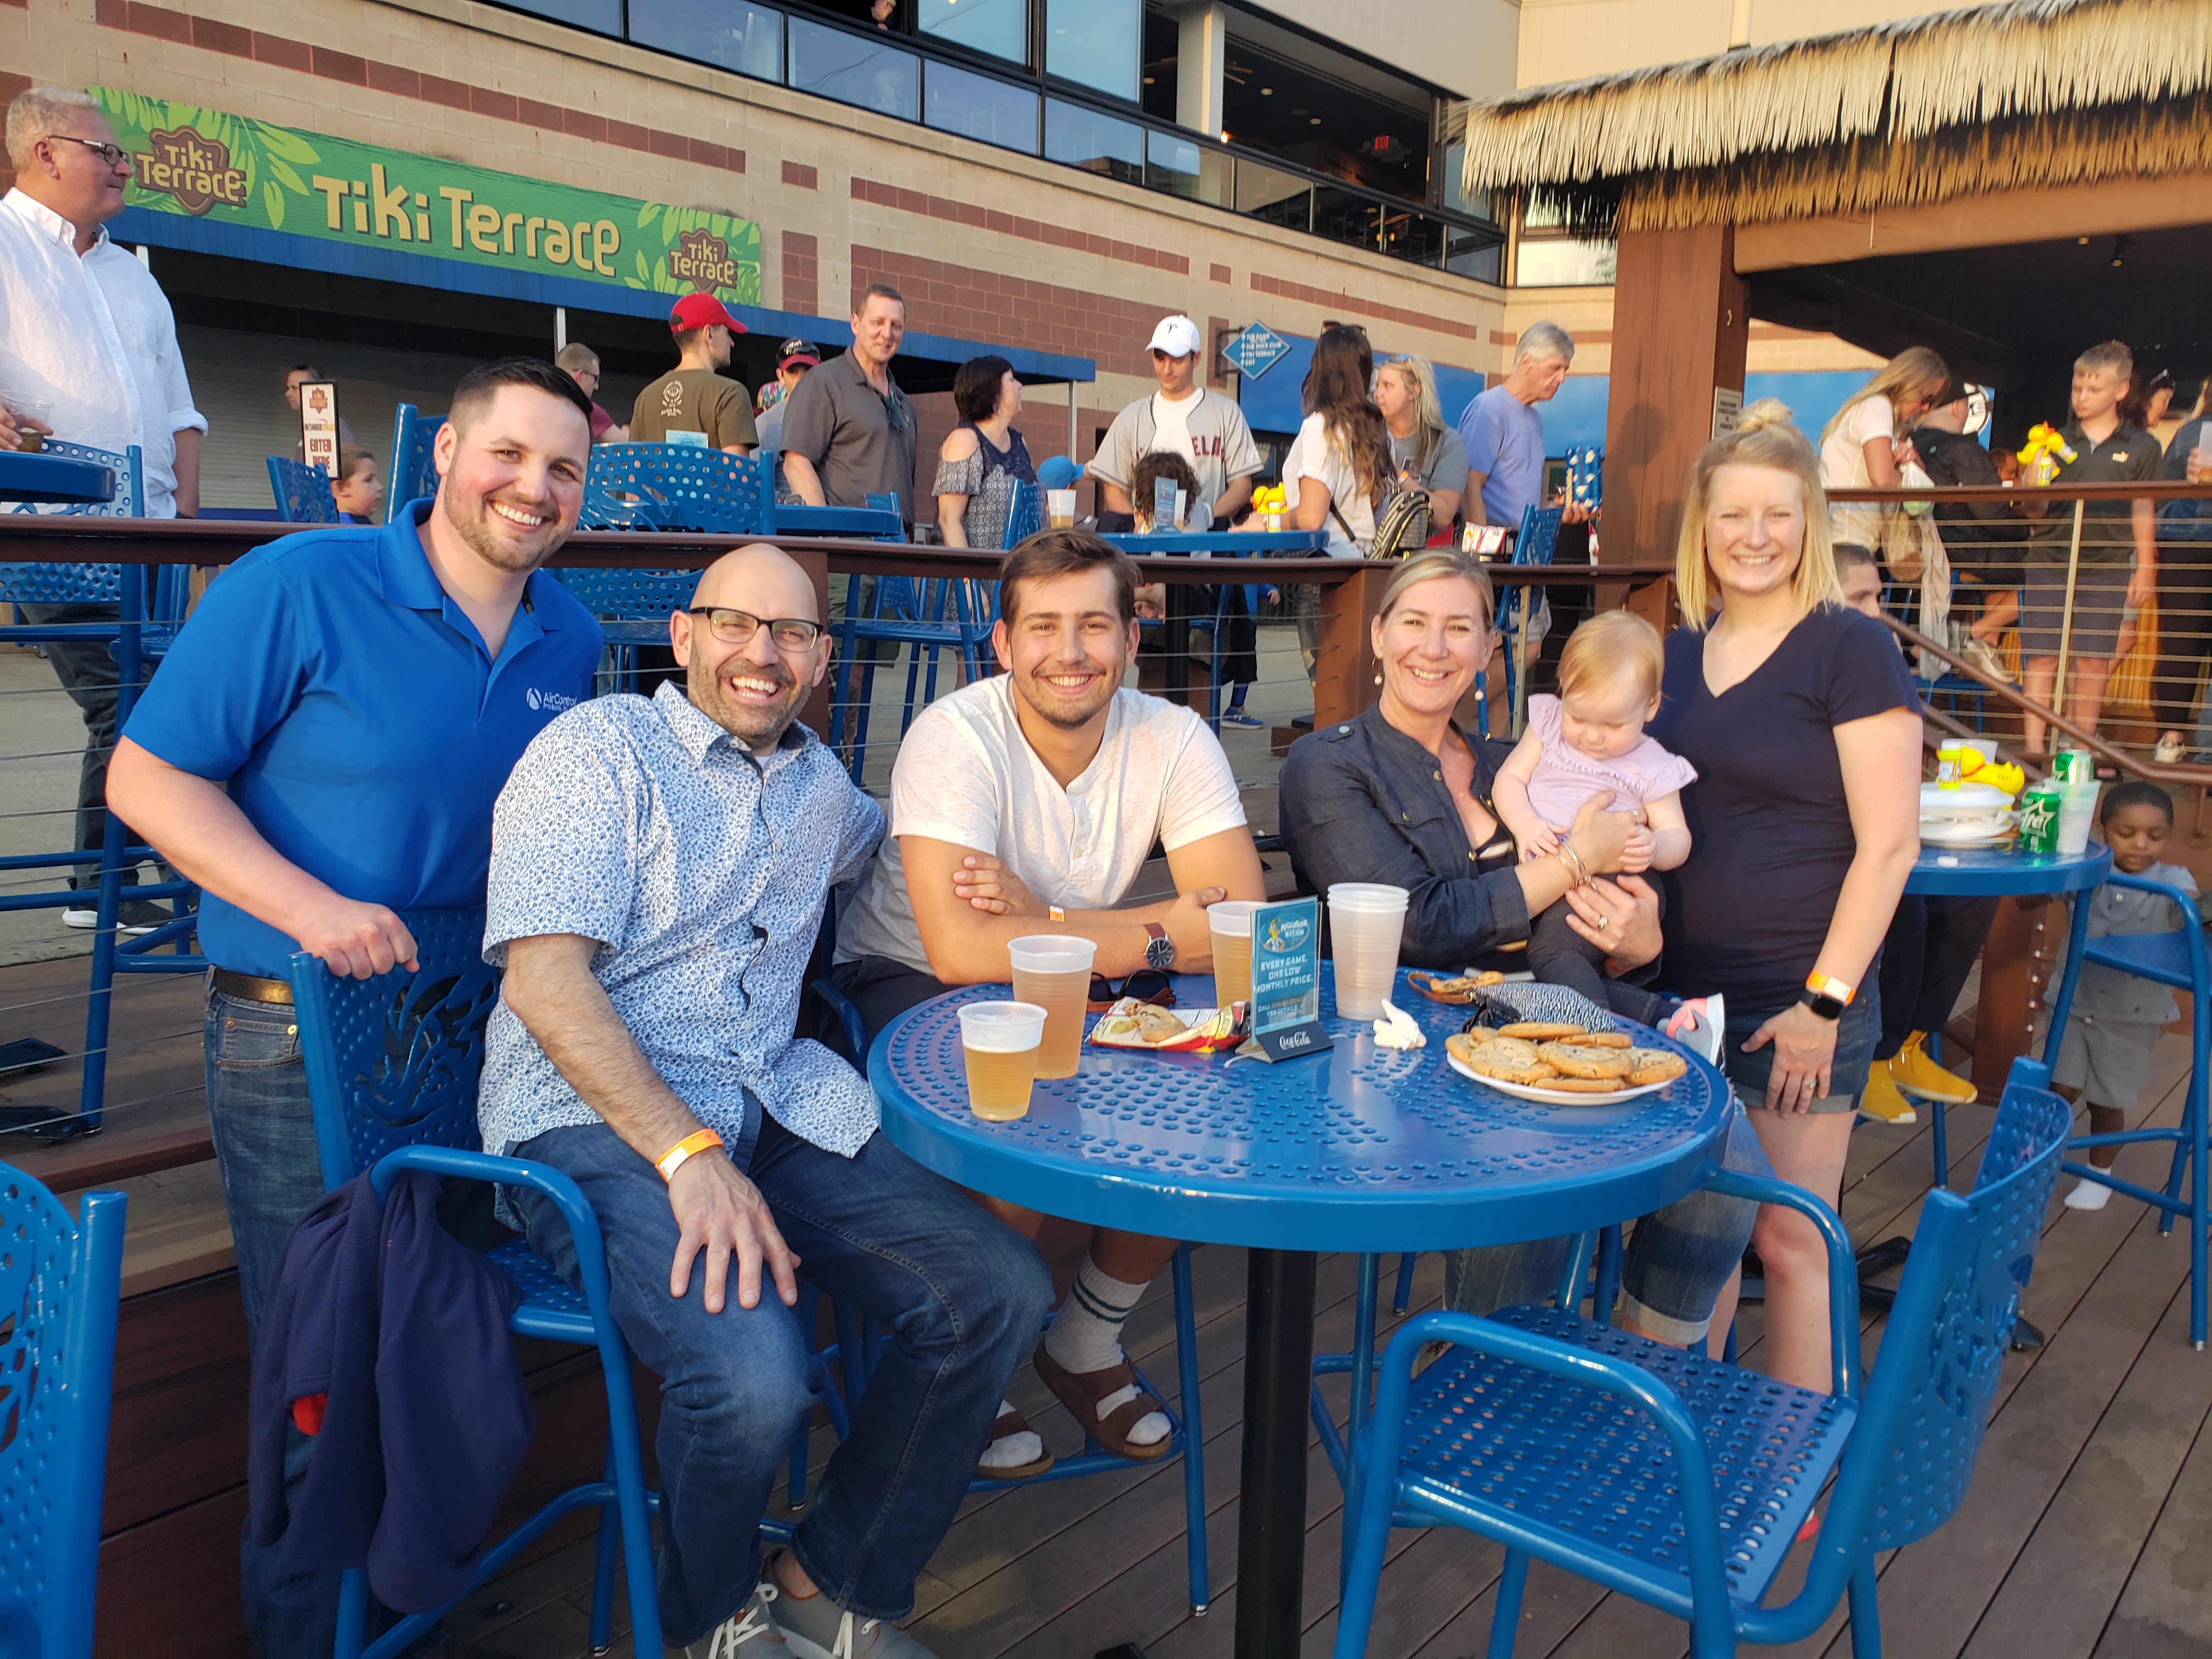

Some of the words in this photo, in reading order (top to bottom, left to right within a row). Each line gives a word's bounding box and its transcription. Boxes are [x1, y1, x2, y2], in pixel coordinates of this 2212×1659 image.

[165, 140, 213, 172] Tiki
[137, 154, 241, 202] Terrace
[313, 163, 432, 242] Tiki
[439, 186, 620, 277] Terrace
[688, 239, 718, 262] Tiki
[670, 251, 735, 285] Terrace
[310, 438, 332, 453] ENTER
[543, 691, 578, 706] AirControl
[1284, 928, 1304, 939] NATION
[1261, 958, 1285, 971] EVERY
[1285, 953, 1308, 966] GAME.
[1268, 969, 1284, 981] ONE
[1284, 966, 1301, 977] LOW
[1255, 979, 1289, 994] MONTHLY
[1290, 973, 1313, 986] PRICE.
[1258, 1003, 1271, 1012] CALL
